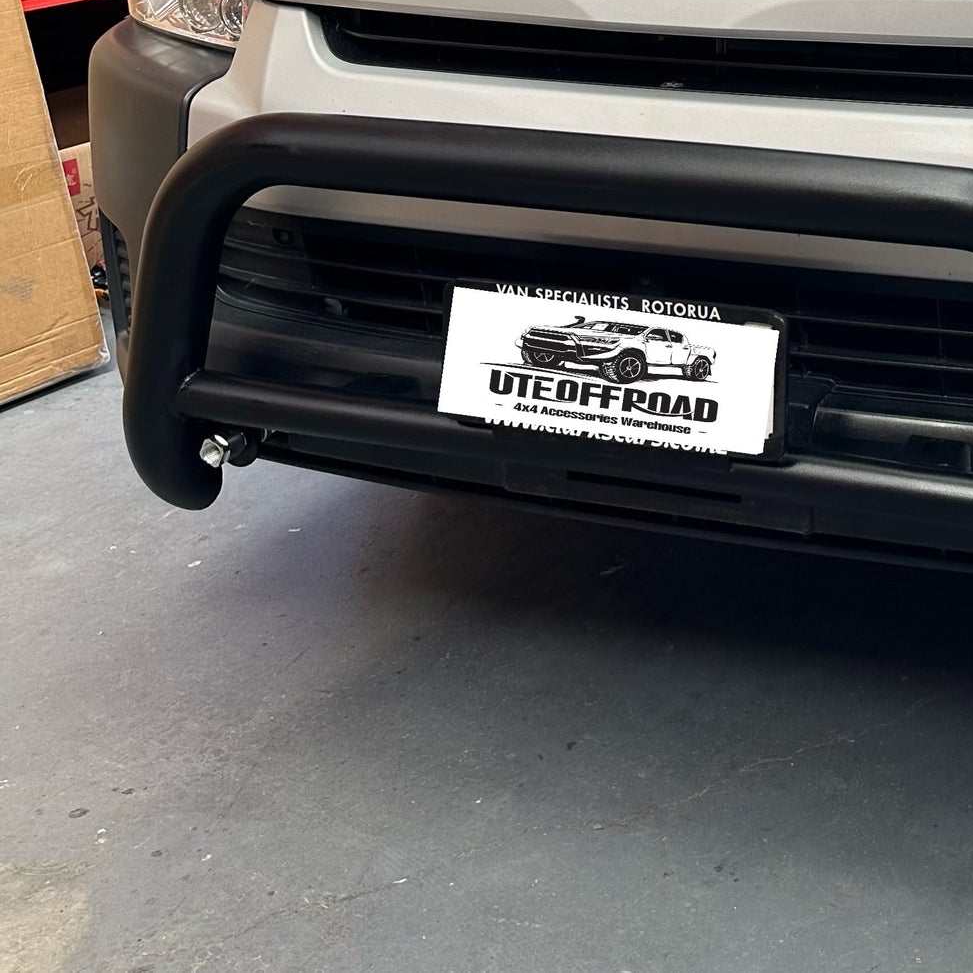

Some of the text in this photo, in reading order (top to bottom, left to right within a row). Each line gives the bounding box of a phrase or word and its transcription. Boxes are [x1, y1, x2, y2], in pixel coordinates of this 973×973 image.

[496, 284, 722, 321] VAN SPECIALISTS ROTORUA
